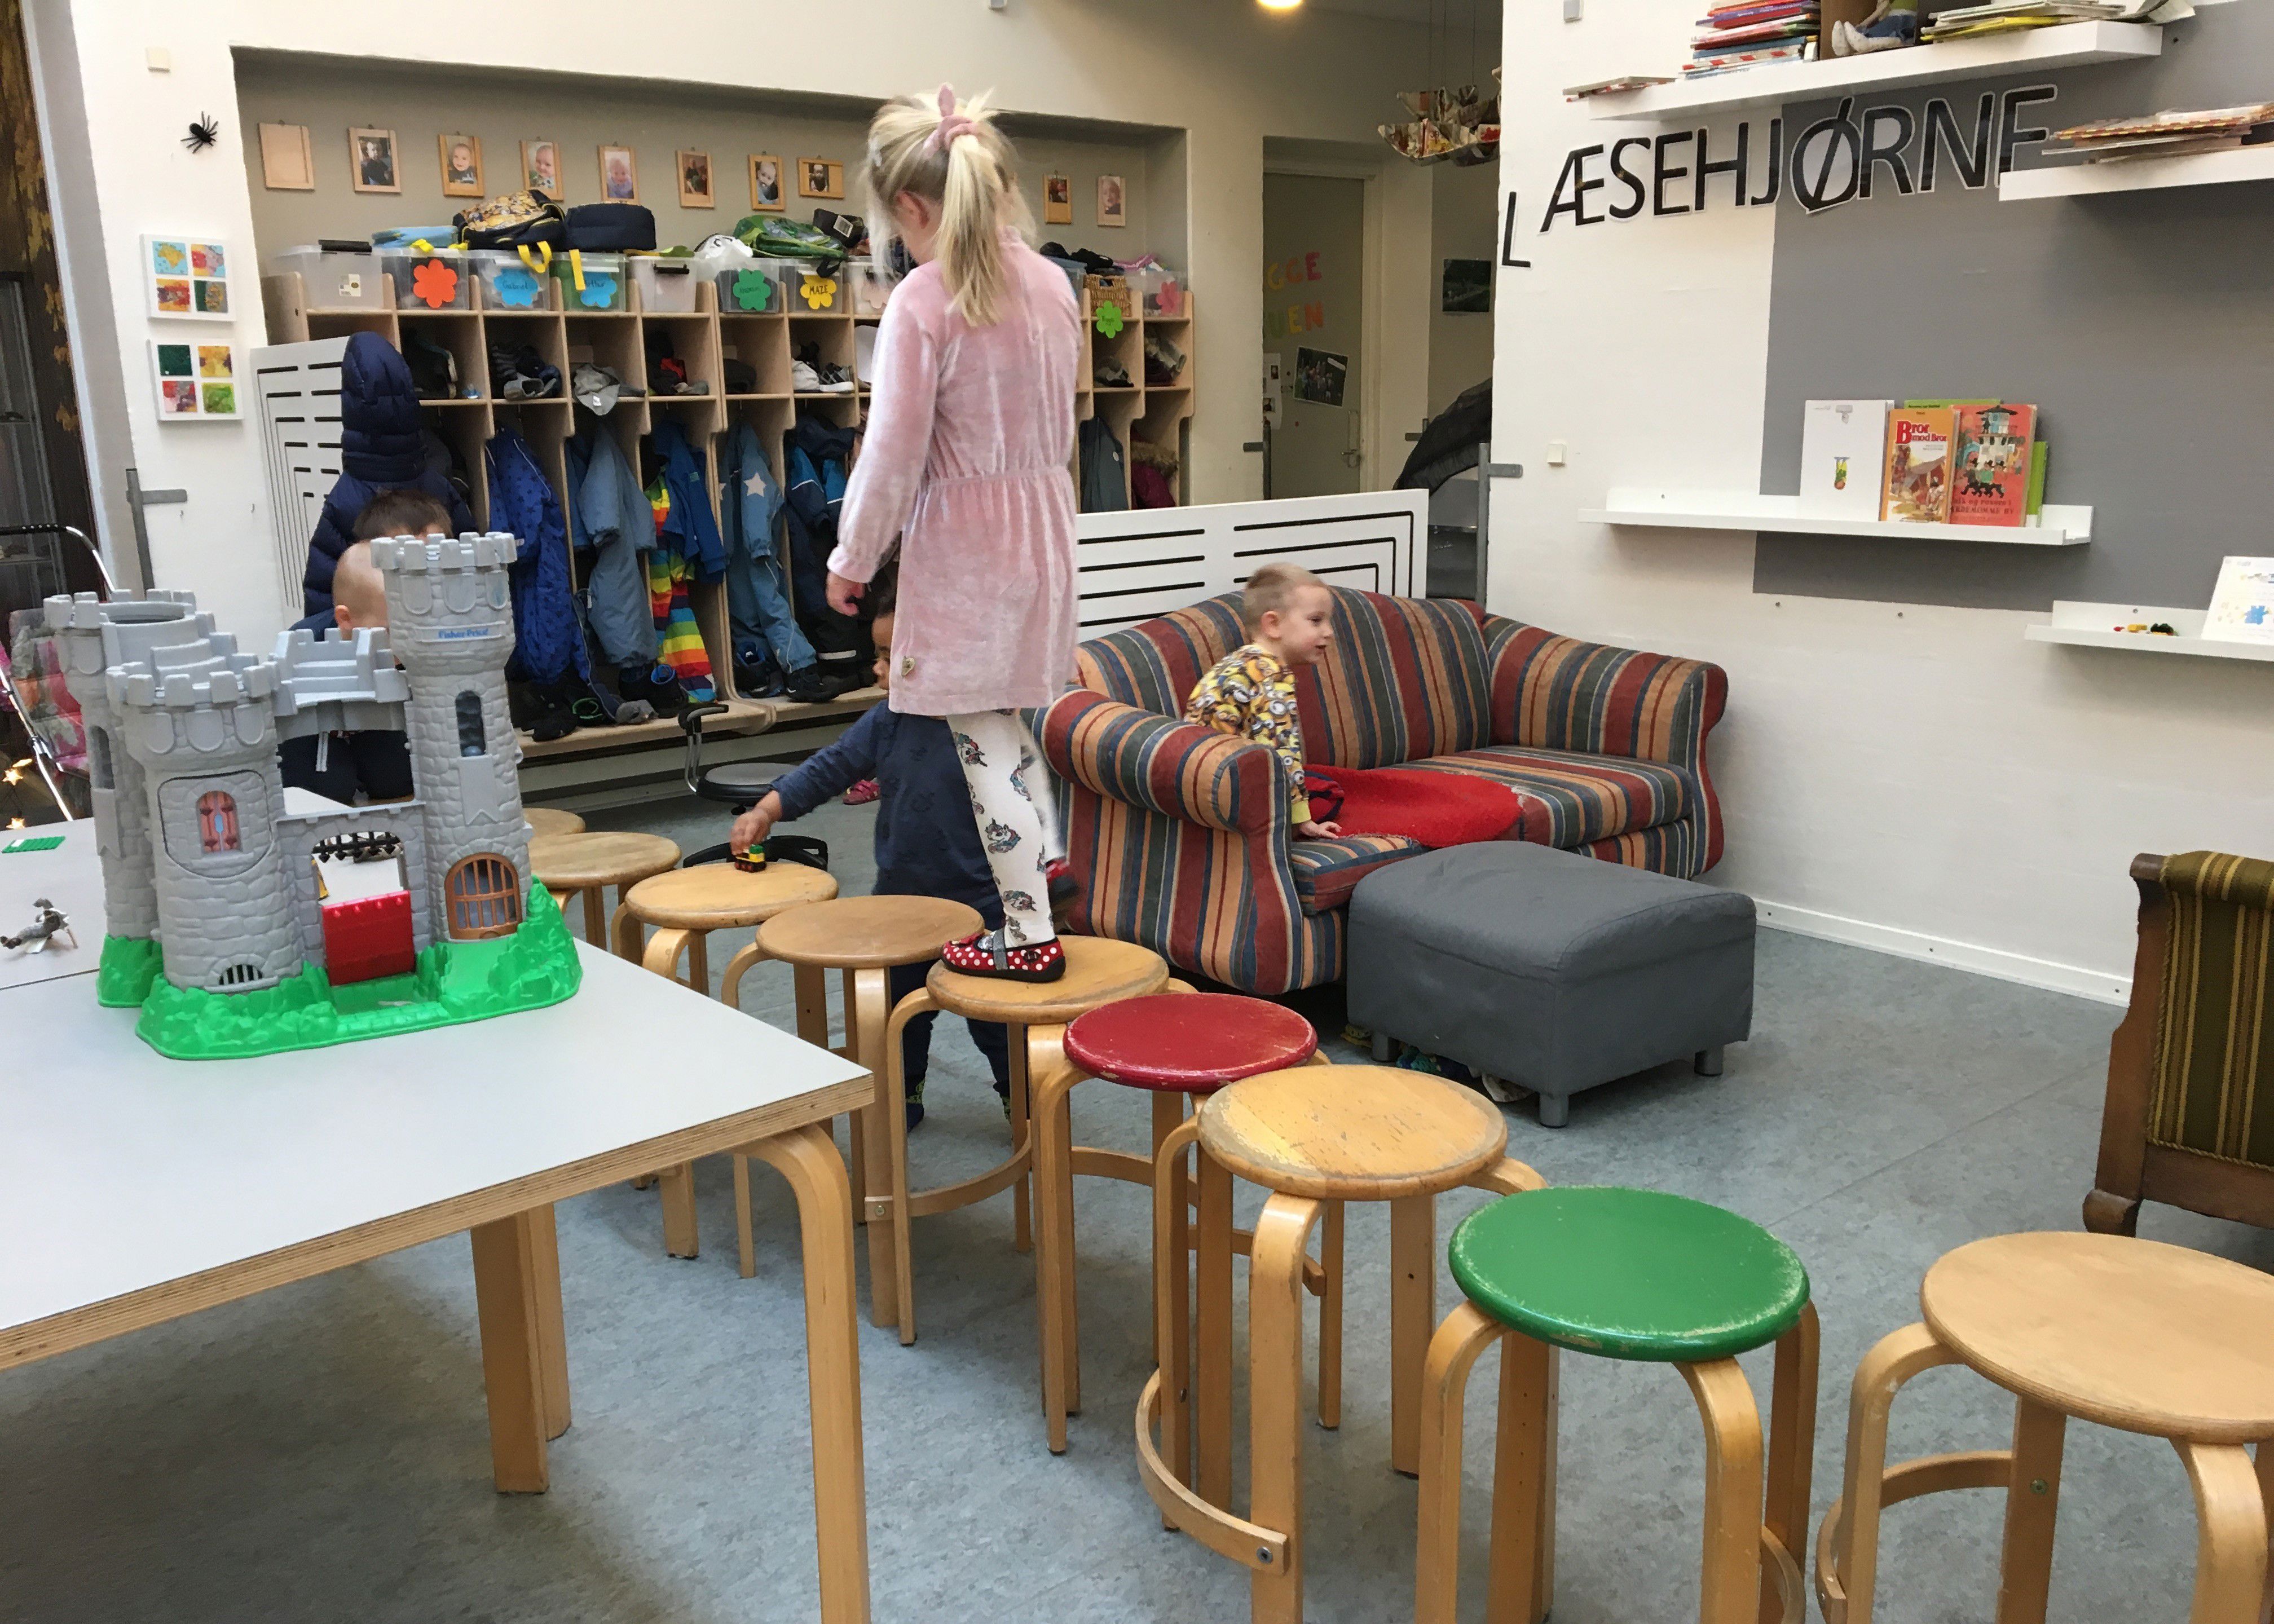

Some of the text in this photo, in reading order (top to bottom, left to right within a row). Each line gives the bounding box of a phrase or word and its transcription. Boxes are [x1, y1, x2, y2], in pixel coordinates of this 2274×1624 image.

[1896, 421, 1930, 444] Bror
[1912, 433, 1947, 442] mod Bror
